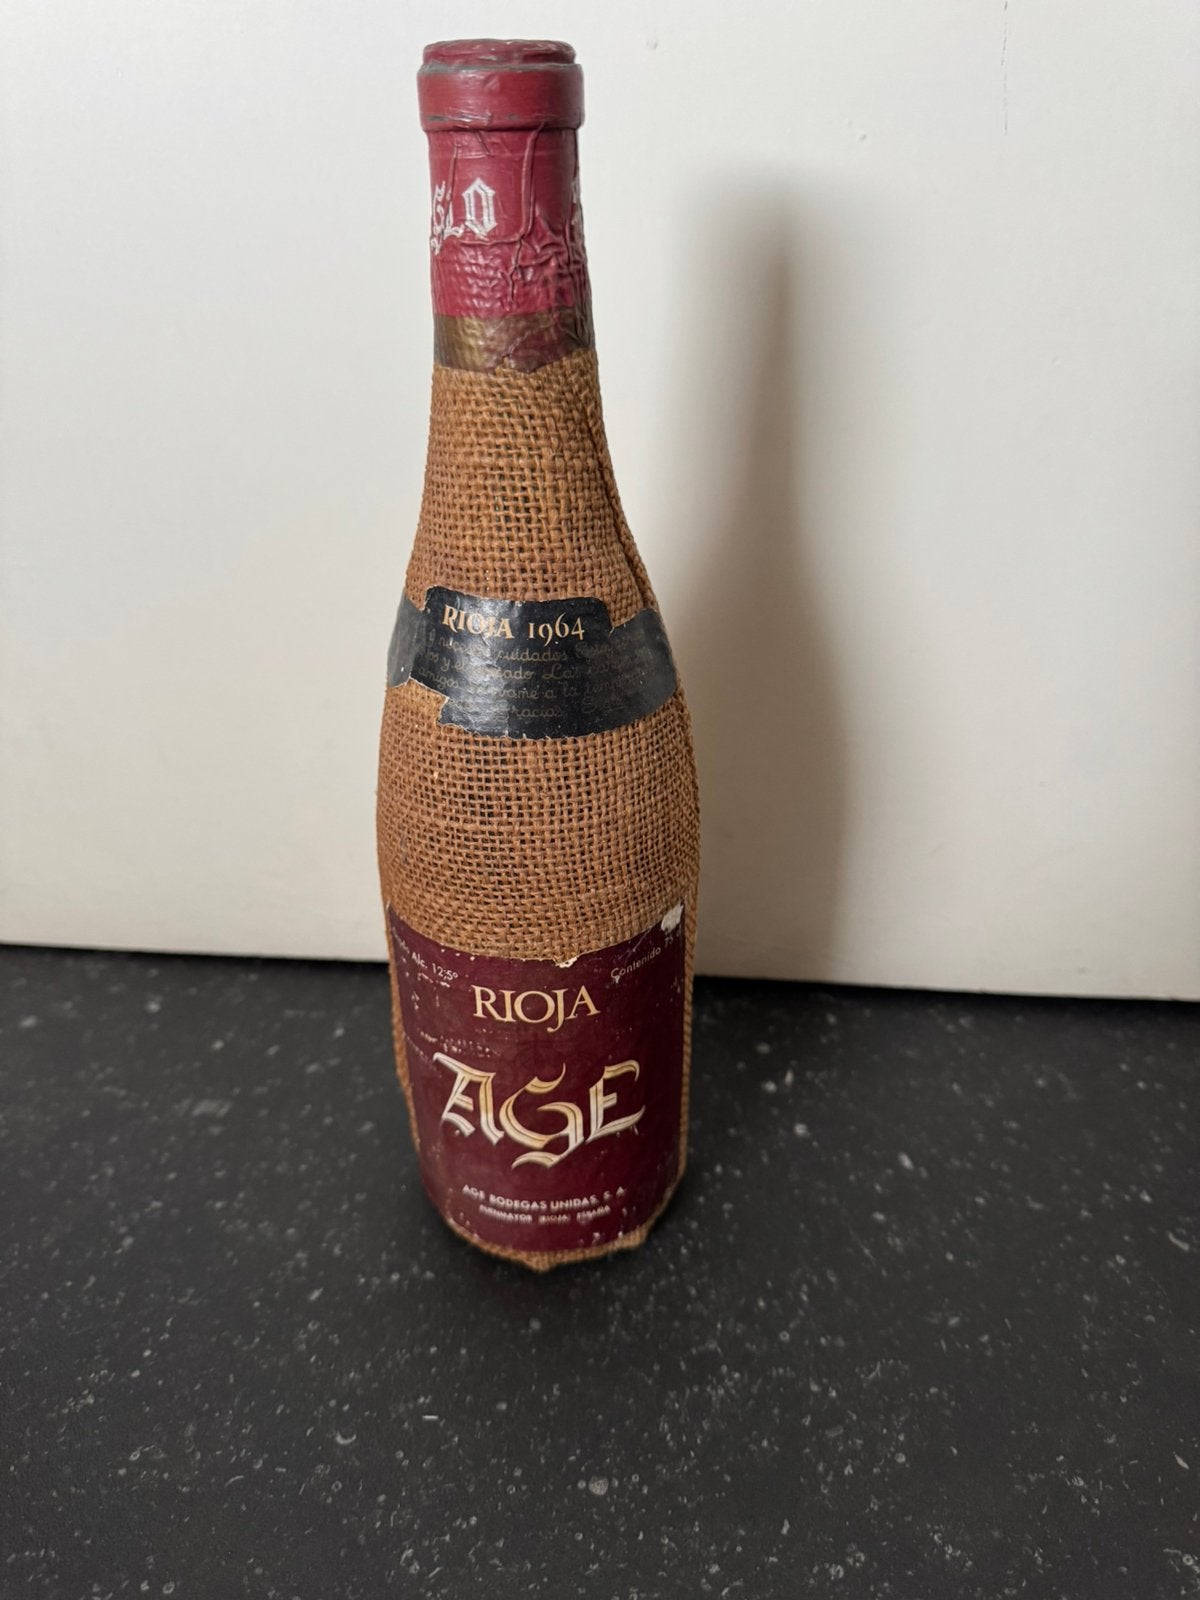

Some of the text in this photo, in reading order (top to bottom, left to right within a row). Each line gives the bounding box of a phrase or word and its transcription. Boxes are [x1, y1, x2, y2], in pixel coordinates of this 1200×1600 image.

[441, 604, 586, 647] RIOJA 1964
[496, 648, 568, 662] cuidados
[610, 946, 662, 978] Contenido
[471, 984, 601, 1033] RIOJA
[432, 1052, 646, 1170] AGE
[488, 1194, 548, 1211] BODEGAS
